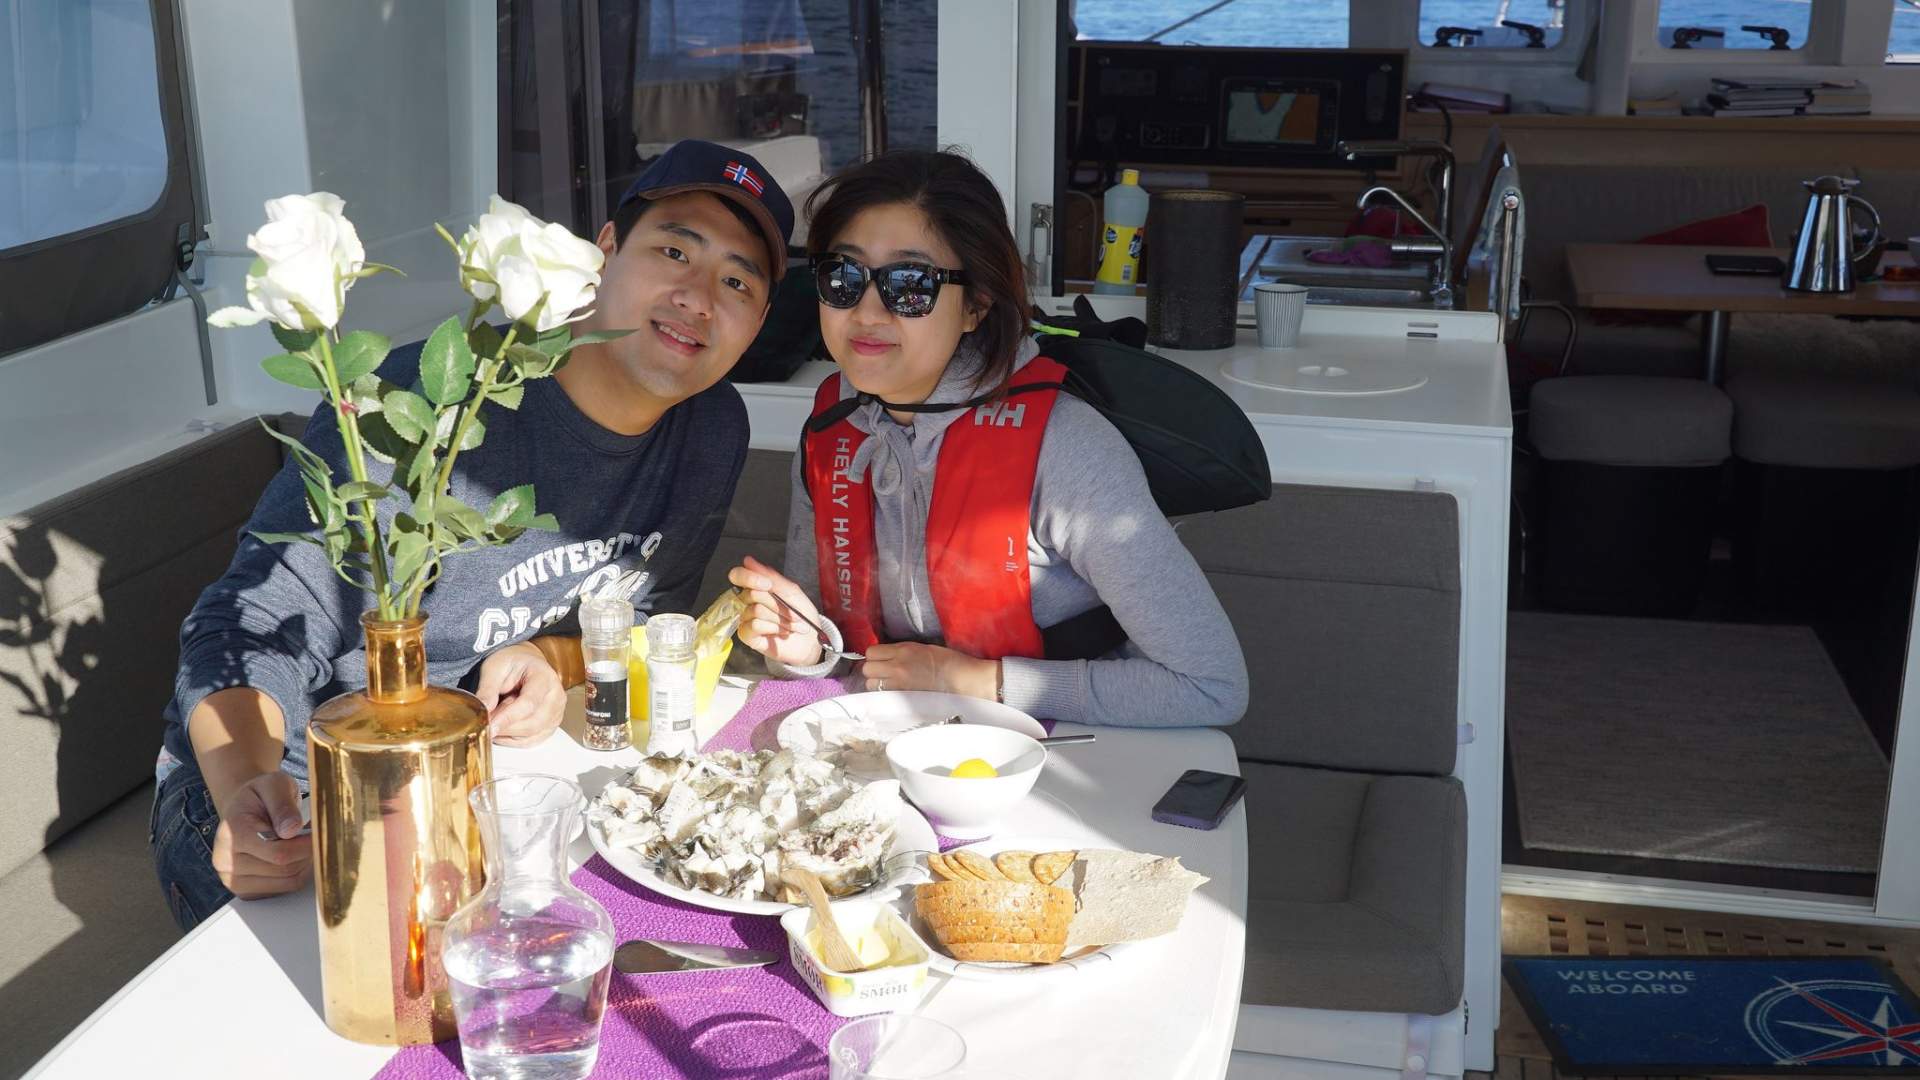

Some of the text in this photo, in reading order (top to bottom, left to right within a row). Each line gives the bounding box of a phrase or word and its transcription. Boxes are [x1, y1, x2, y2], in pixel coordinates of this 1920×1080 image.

[974, 402, 1026, 428] HH
[832, 437, 852, 612] HELLY HANSEN
[499, 532, 641, 598] UNIVERST
[1558, 970, 1697, 981] WELCOME
[1568, 983, 1689, 995] ABOARD
